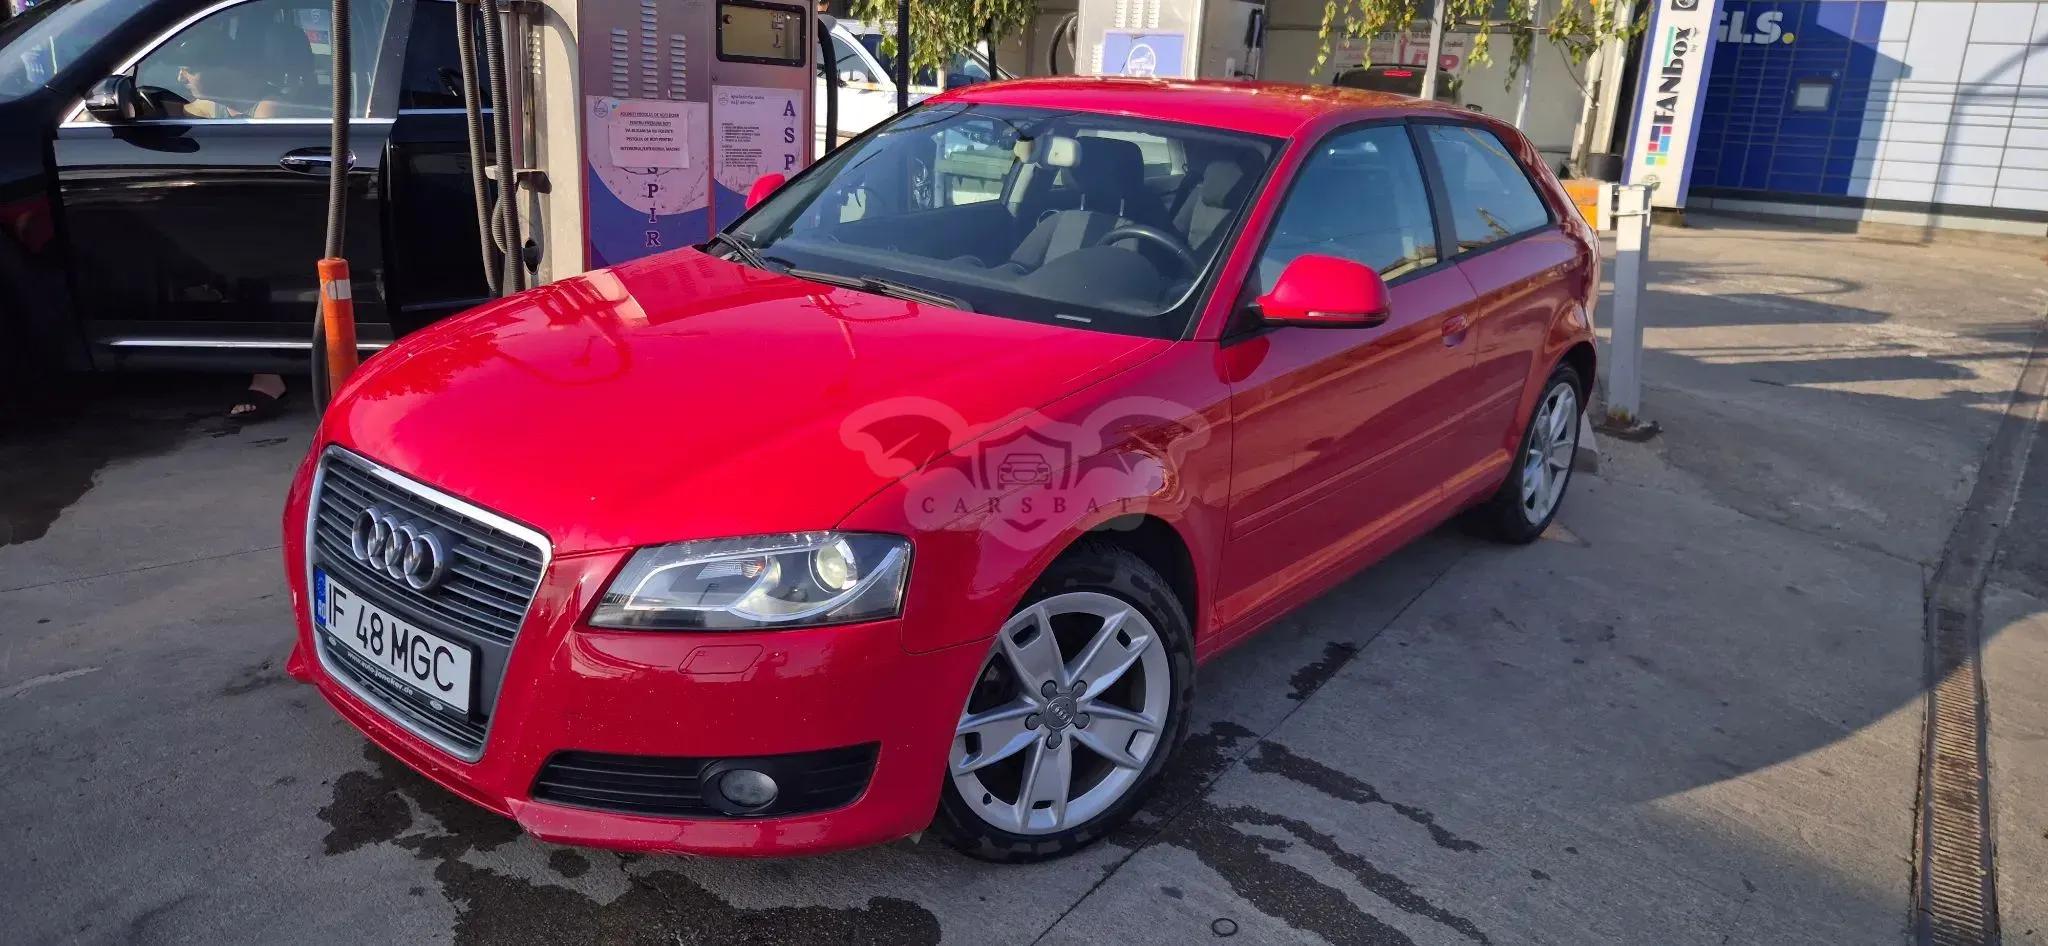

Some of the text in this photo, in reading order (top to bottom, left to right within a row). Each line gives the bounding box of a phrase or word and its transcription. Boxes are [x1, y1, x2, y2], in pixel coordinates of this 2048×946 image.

[1653, 27, 1691, 125] FANbox
[329, 583, 455, 692] IF 48 MGC
